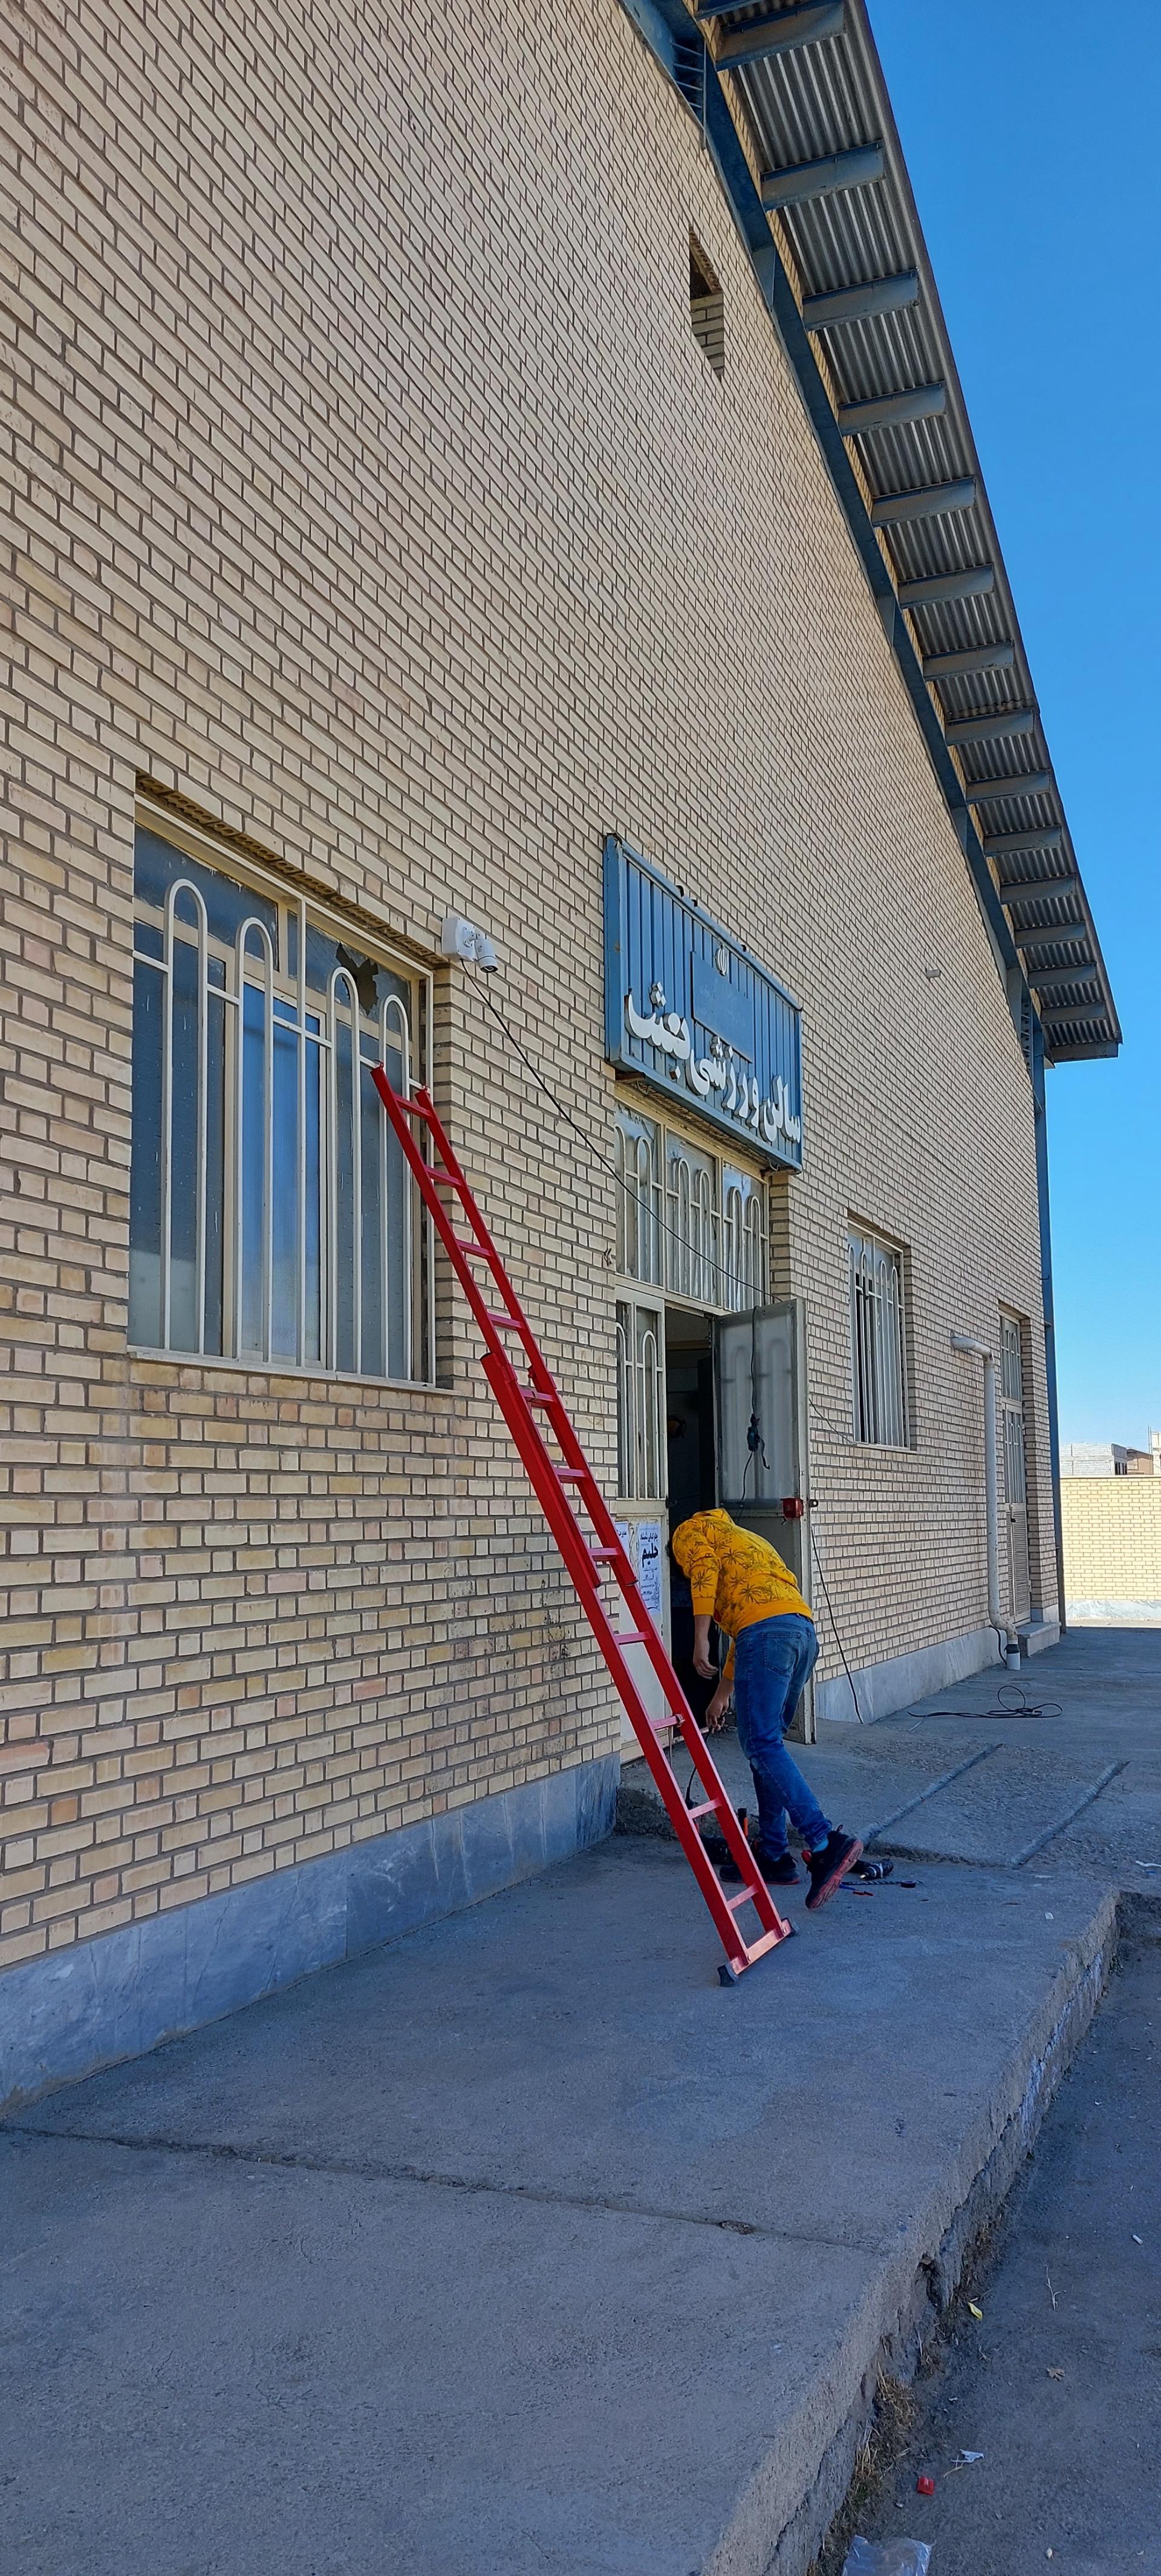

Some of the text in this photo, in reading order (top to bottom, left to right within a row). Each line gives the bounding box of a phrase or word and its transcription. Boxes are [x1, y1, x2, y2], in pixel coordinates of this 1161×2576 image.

[688, 1036, 760, 1129] ورزشی
[763, 1075, 801, 1144] سالن
[642, 1542, 659, 1568] حلیم
